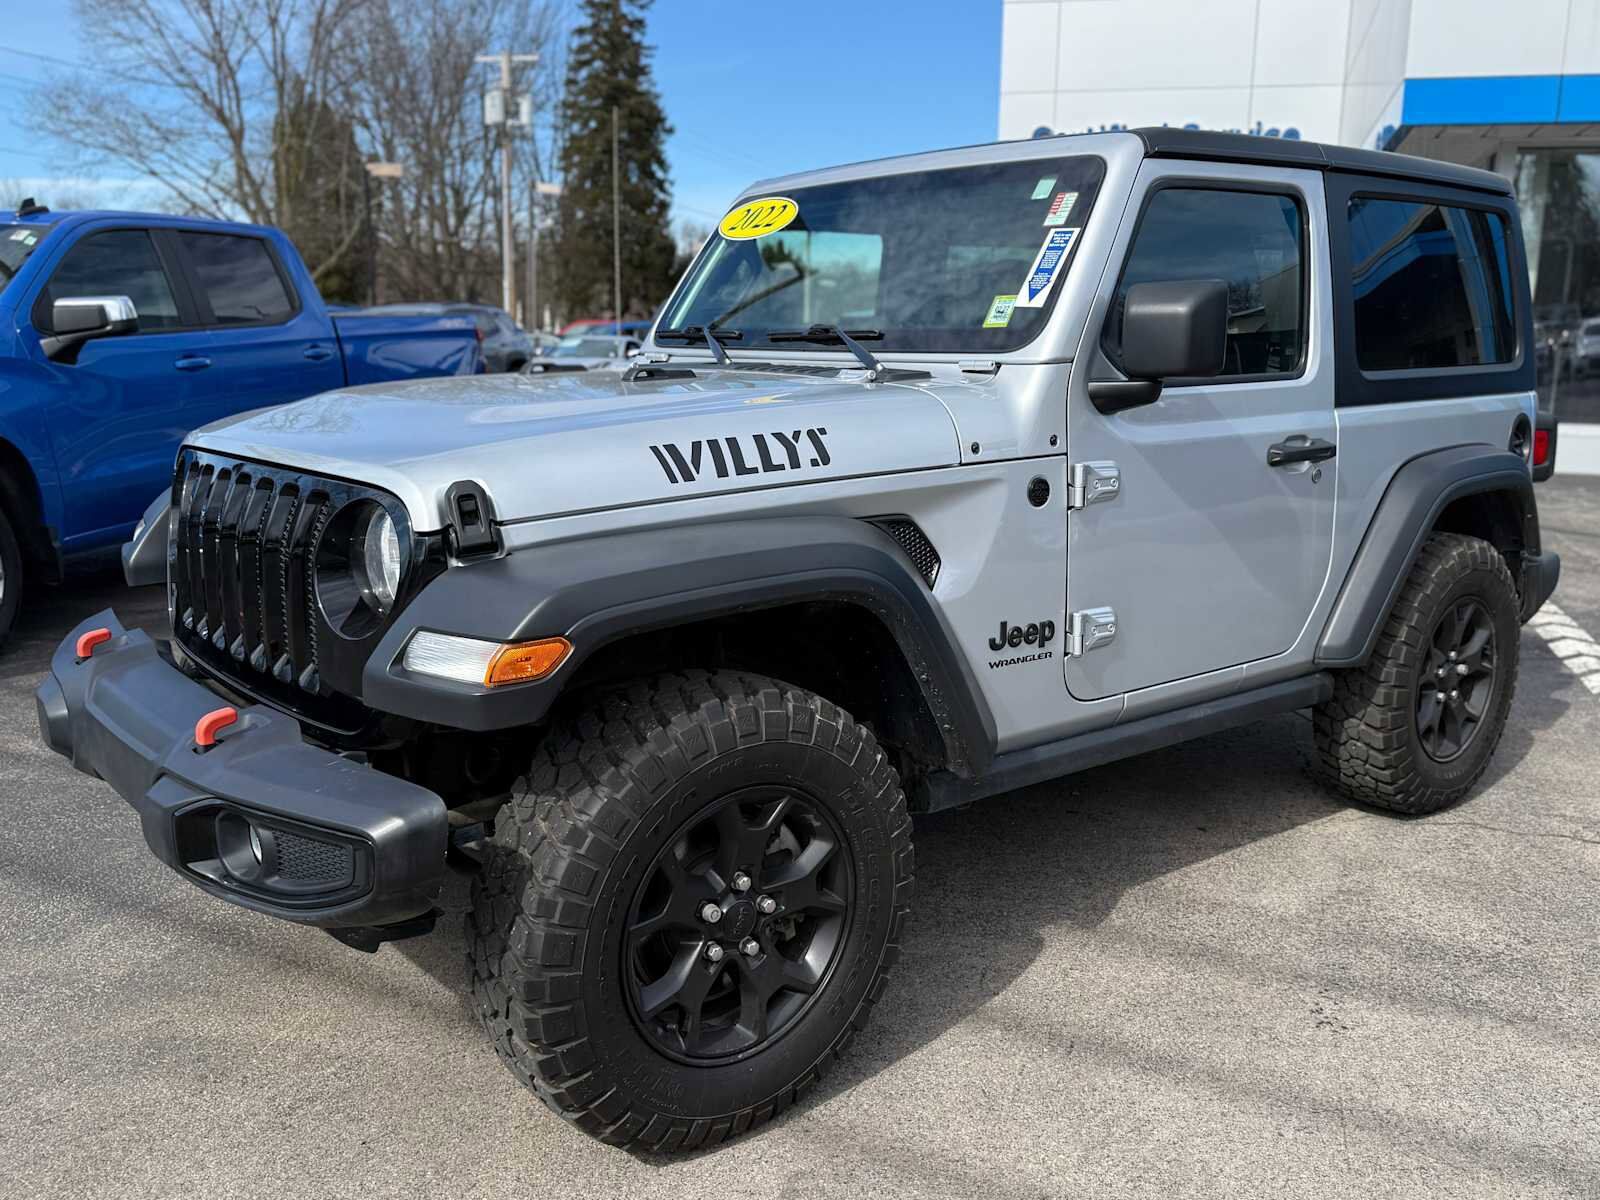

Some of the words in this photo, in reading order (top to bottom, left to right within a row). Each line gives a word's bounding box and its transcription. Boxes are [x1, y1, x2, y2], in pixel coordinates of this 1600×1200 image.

[728, 204, 788, 231] 2022
[649, 427, 831, 484] WILLYS
[989, 620, 1055, 651] Jeep
[988, 651, 1053, 670] WRANGLER
